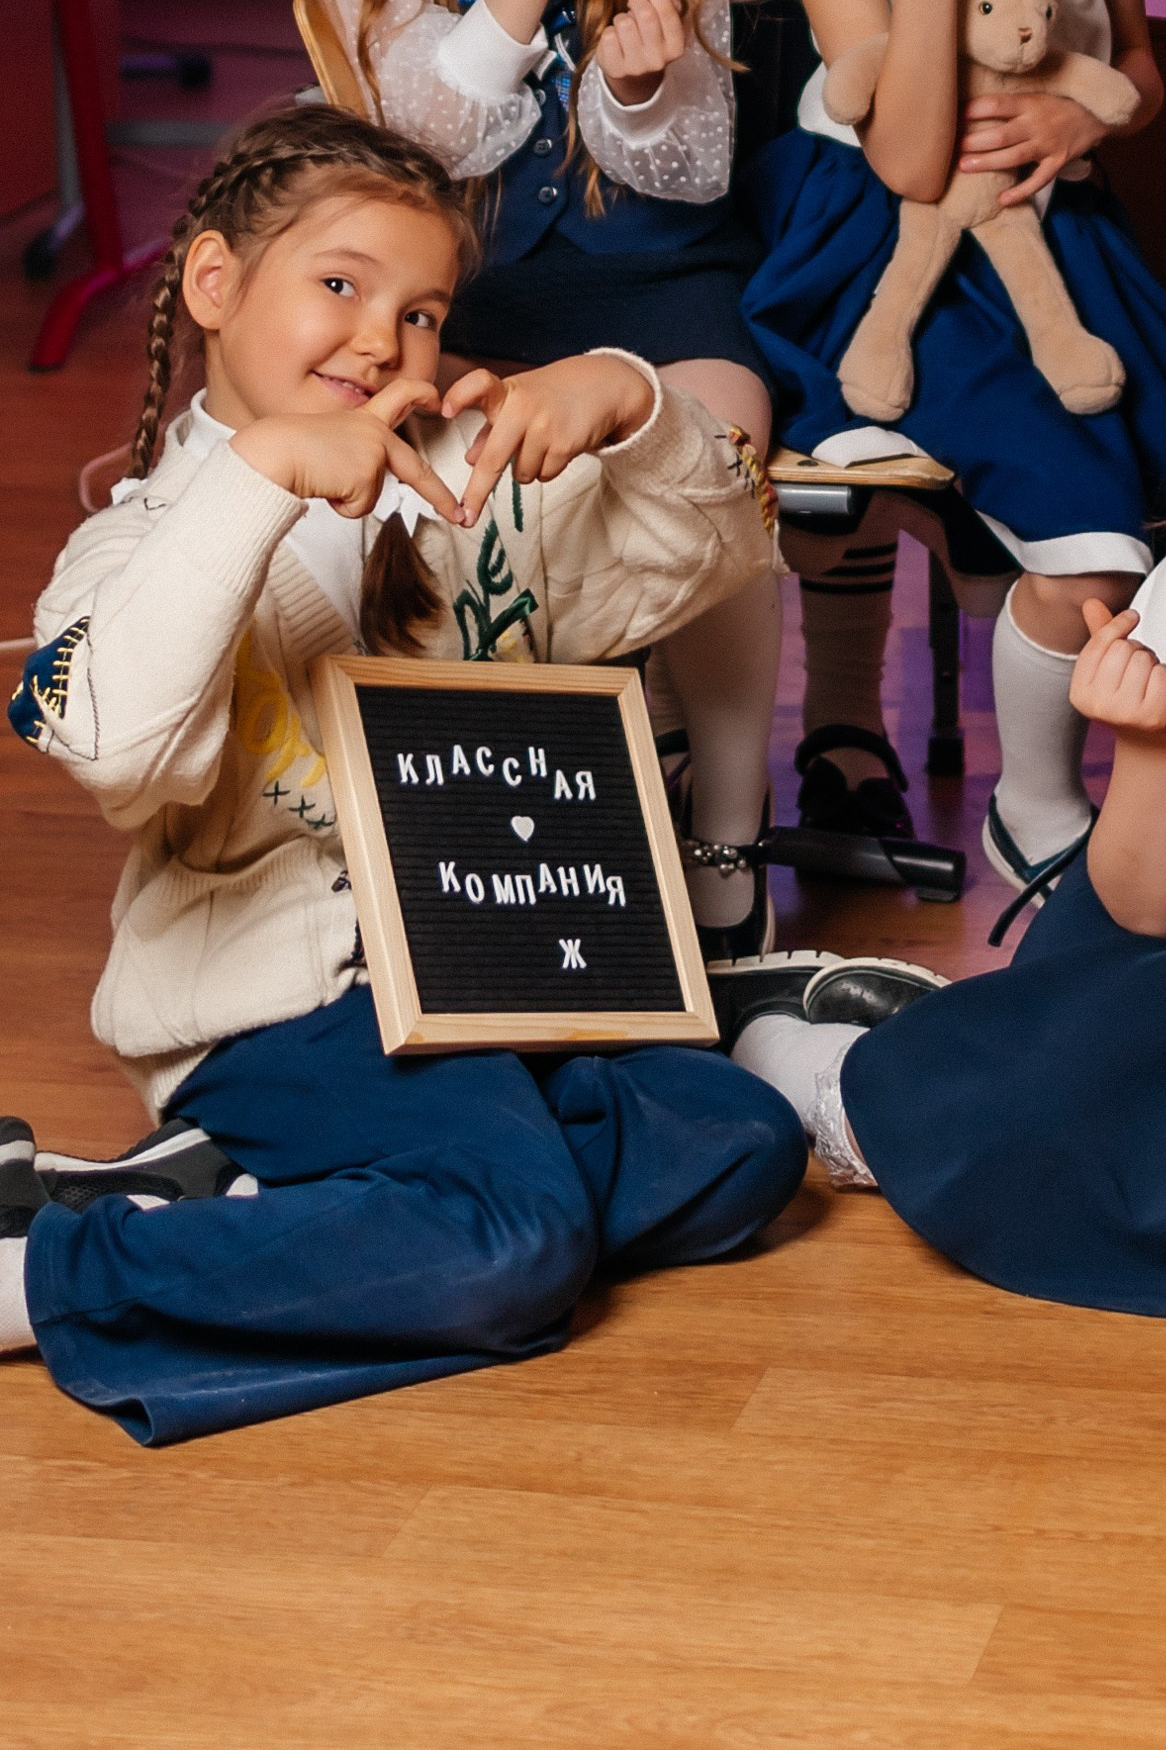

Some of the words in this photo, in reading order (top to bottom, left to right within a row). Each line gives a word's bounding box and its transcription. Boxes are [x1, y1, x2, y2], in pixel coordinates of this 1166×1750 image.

[397, 744, 596, 801] КЛАССНАЯ
[438, 861, 626, 907] КОМПАНИЯ
[558, 938, 587, 970] Ж
